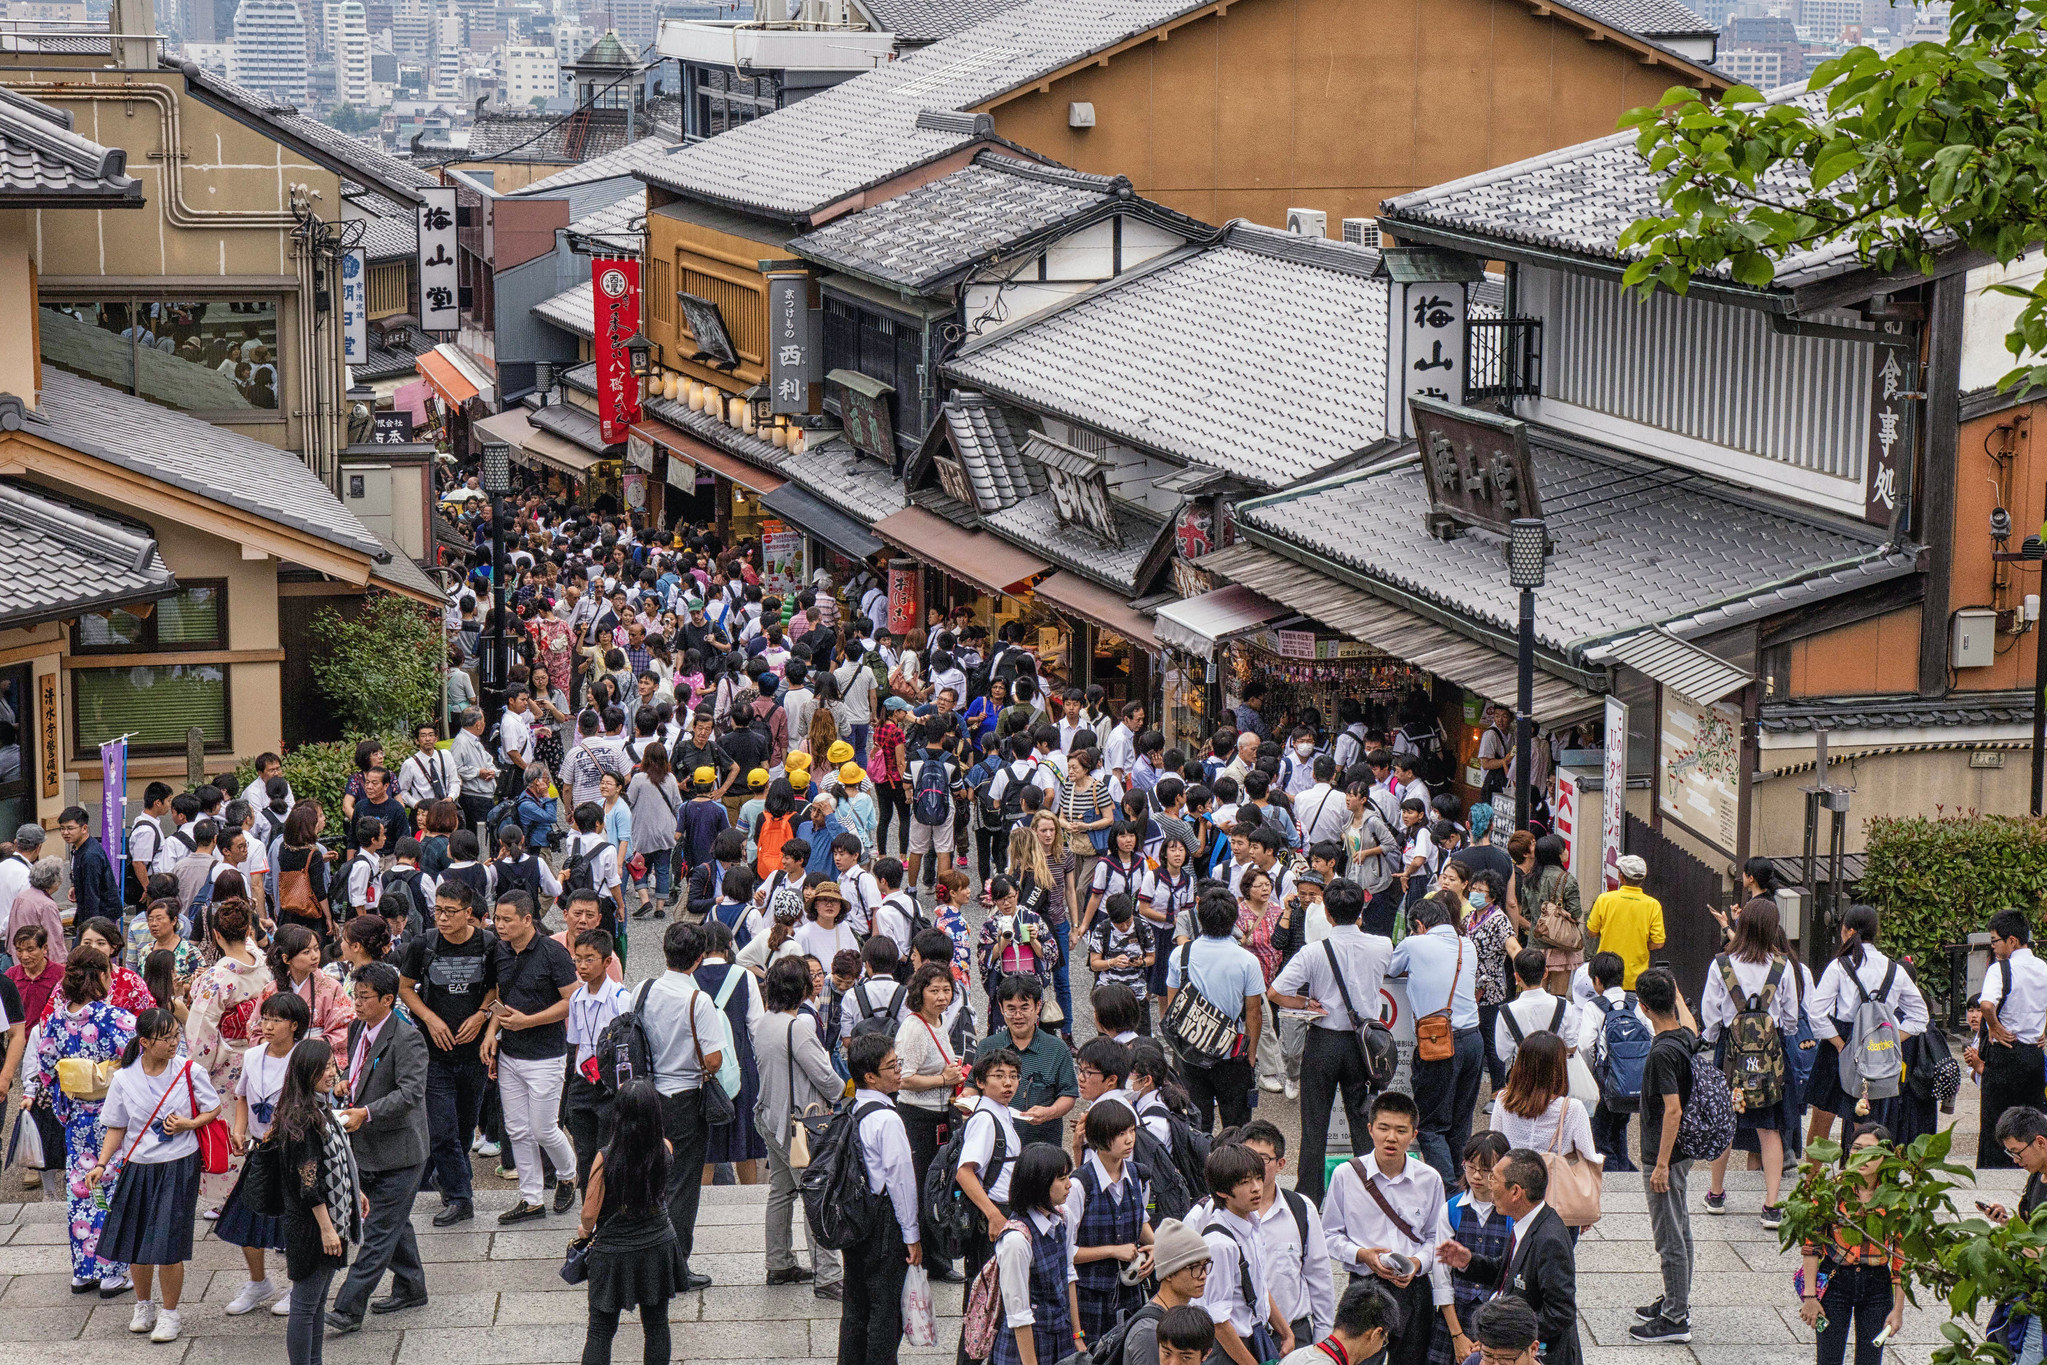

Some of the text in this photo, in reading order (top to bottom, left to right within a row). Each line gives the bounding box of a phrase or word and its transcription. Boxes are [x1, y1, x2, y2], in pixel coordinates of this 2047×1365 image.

[423, 206, 457, 312] 梅山堂
[609, 274, 620, 294] 西尾
[784, 288, 795, 339] 京つけもの
[778, 344, 802, 402] 西利
[375, 418, 403, 428] 限会社
[45, 687, 57, 785] 清水寺警備室
[1608, 729, 1617, 837] Uターン
[448, 983, 469, 992] EA7
[1867, 1040, 1894, 1051] Barbie
[1746, 1056, 1760, 1072] NY
